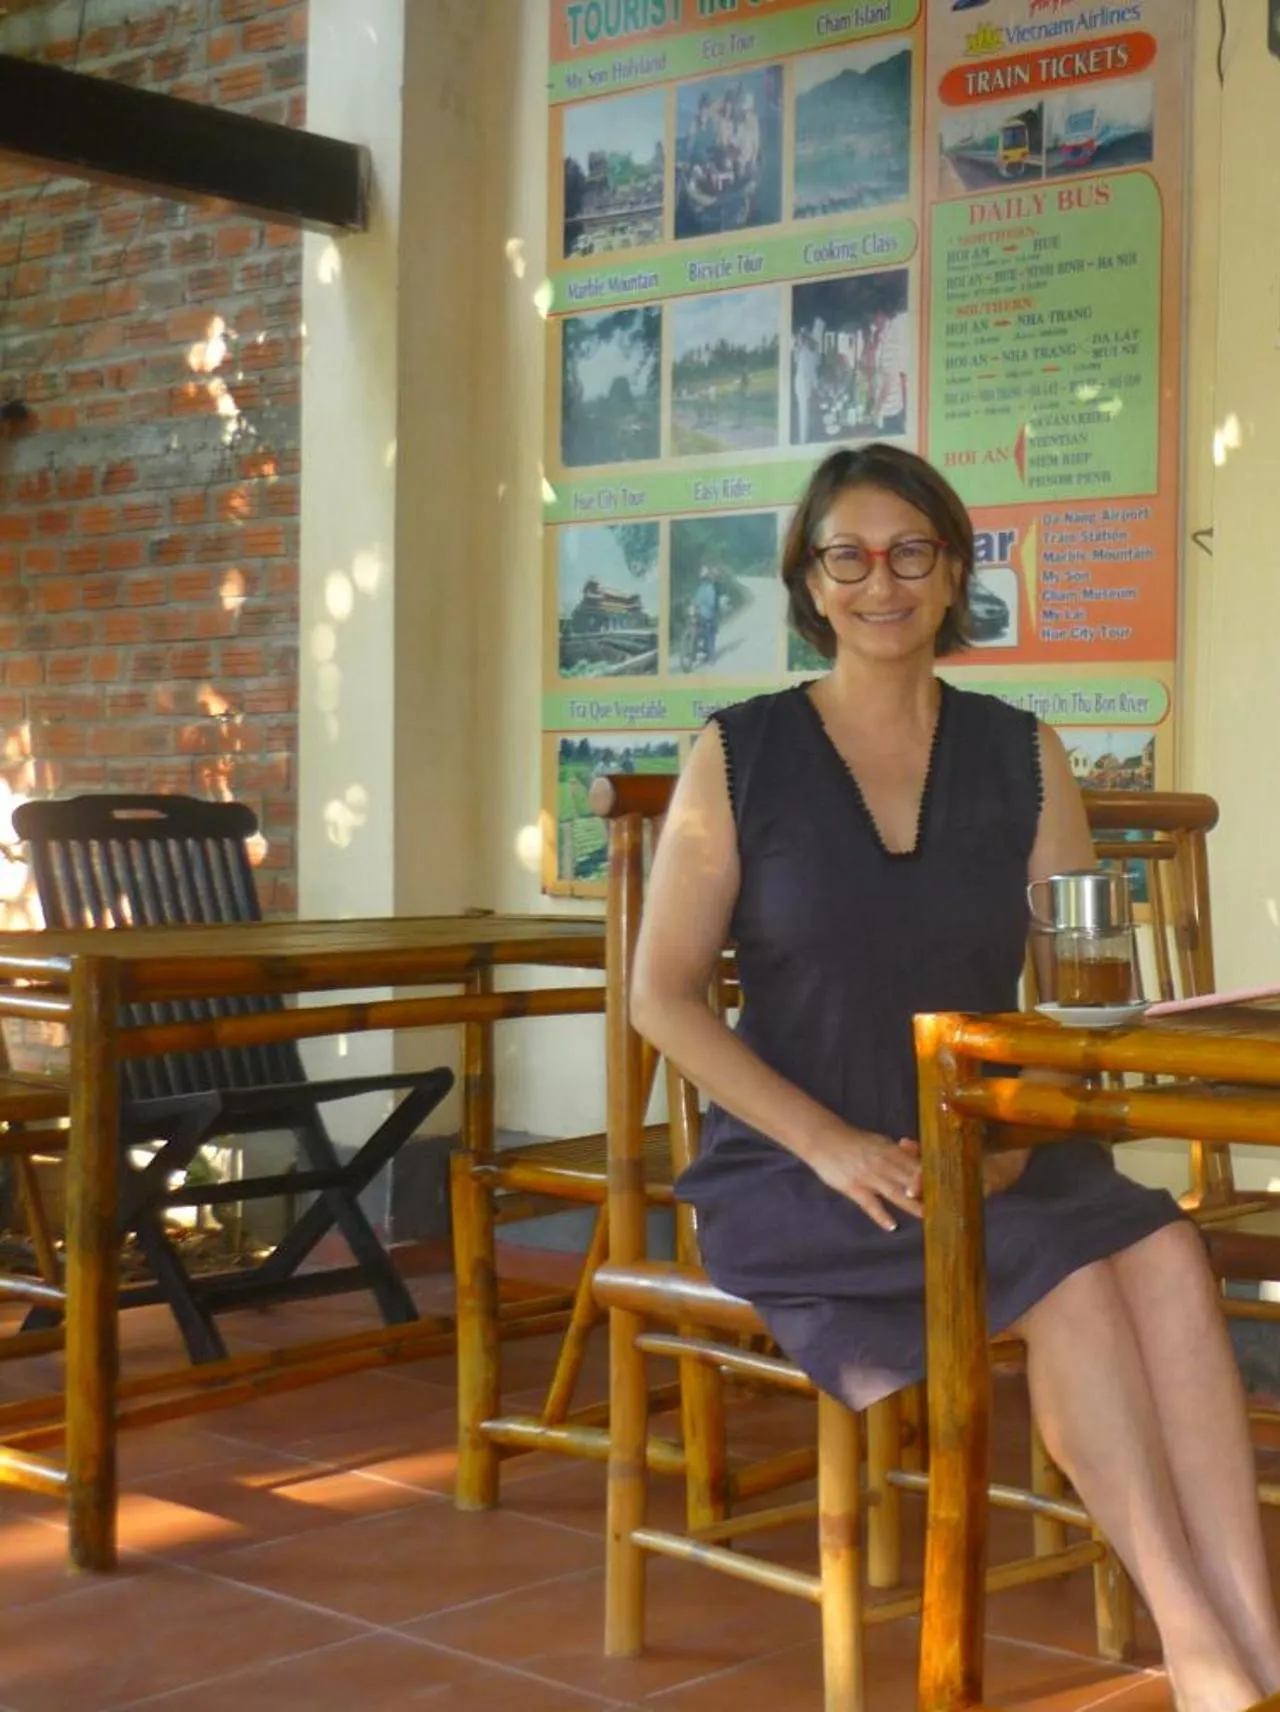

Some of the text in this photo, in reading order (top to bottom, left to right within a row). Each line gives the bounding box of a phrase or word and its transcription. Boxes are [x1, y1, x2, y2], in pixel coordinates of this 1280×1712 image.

[566, 0, 682, 46] TOURIST
[817, 4, 891, 36] Cham Island
[1005, 17, 1075, 44] Vietnam
[1076, 4, 1141, 31] Airlines
[702, 33, 757, 59] Eco Tour
[588, 69, 608, 83] Son
[612, 54, 667, 83] Holyland
[965, 44, 1129, 97] TRAIN TICKETS
[968, 183, 1113, 226] DAILY BUS
[803, 230, 899, 265] Cooking Class
[688, 254, 765, 283] Bicycle Tour
[568, 271, 659, 300] Marble Mountain
[944, 447, 1010, 467] HOI AN
[1101, 506, 1150, 524] Airport
[972, 529, 1015, 563] ar
[1091, 547, 1154, 562] Mountain
[1042, 569, 1090, 584] My Son
[1100, 624, 1131, 639] Tour
[1052, 693, 1067, 714] On
[1070, 691, 1092, 714] Thu
[1119, 691, 1151, 714] River
